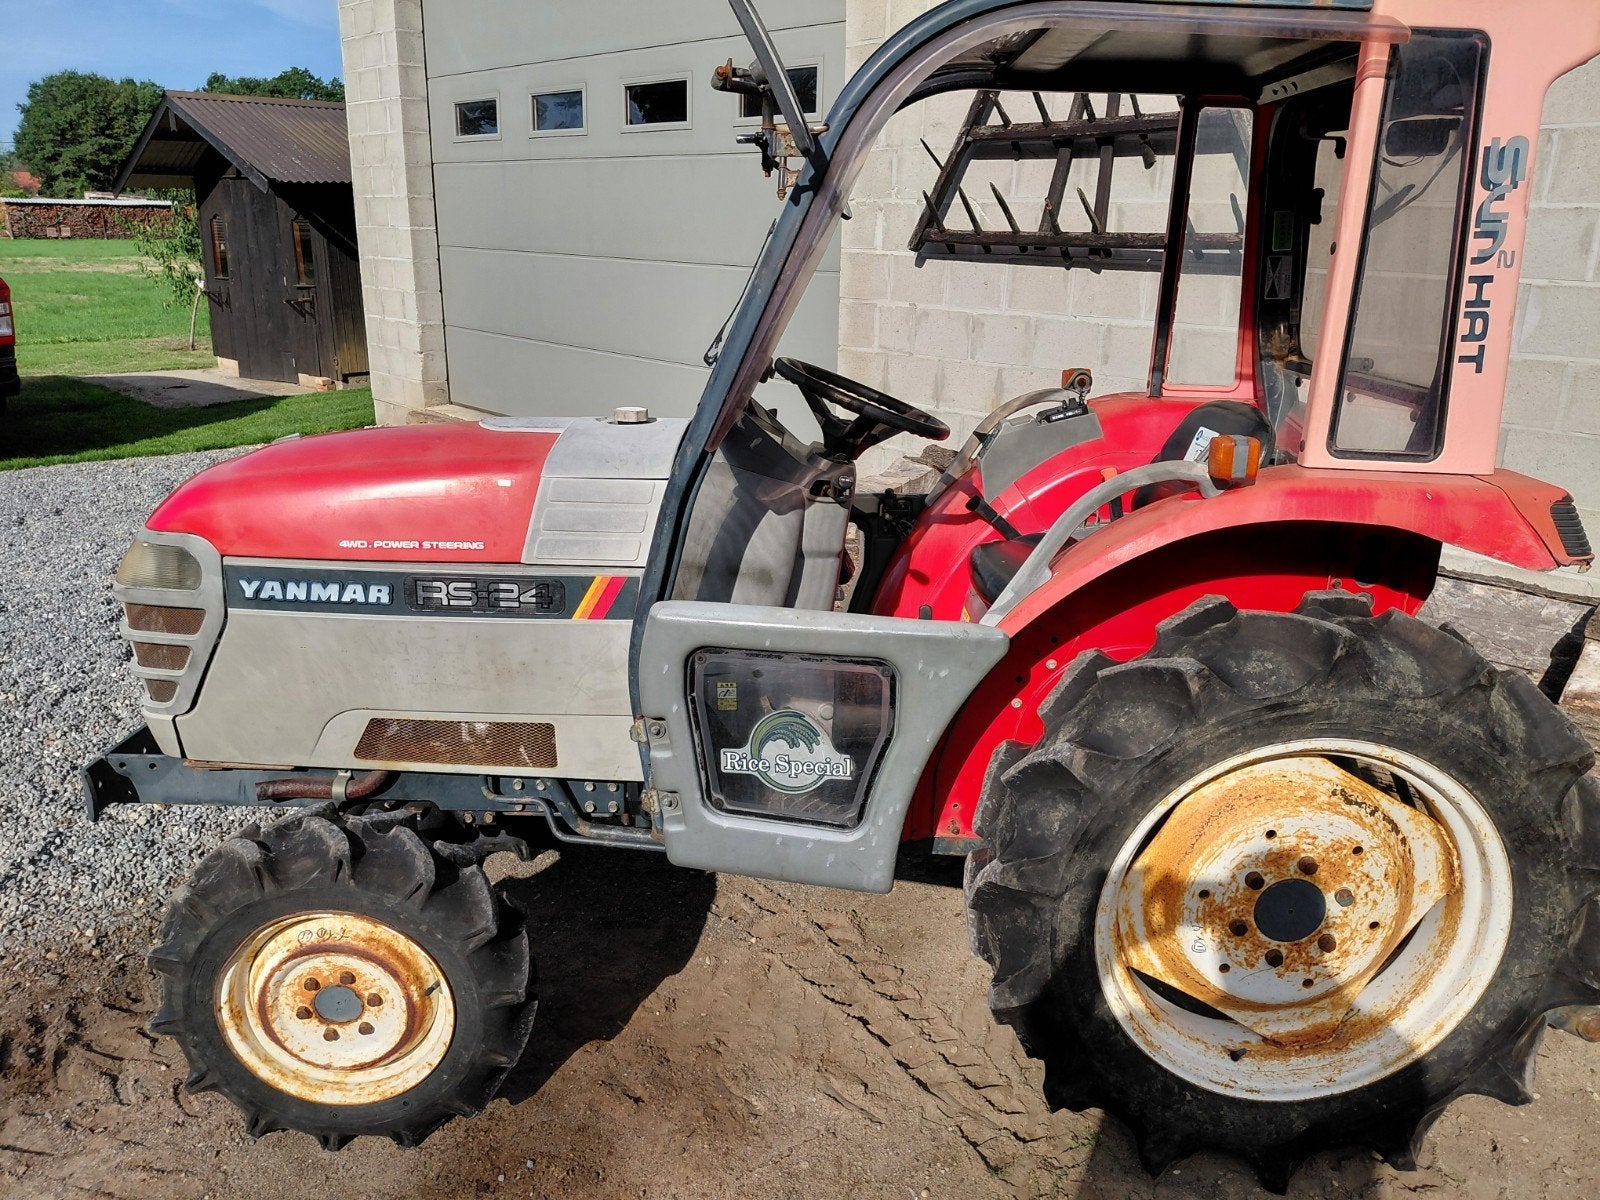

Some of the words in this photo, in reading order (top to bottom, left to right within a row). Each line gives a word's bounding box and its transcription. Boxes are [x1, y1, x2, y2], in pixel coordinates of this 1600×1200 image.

[1458, 275, 1494, 374] HAT
[373, 540, 420, 549] POWER
[422, 541, 485, 550] STEERING
[238, 578, 393, 604] YANMAR
[415, 580, 553, 609] RS-24
[724, 752, 770, 772] Rice
[775, 754, 851, 778] Special
